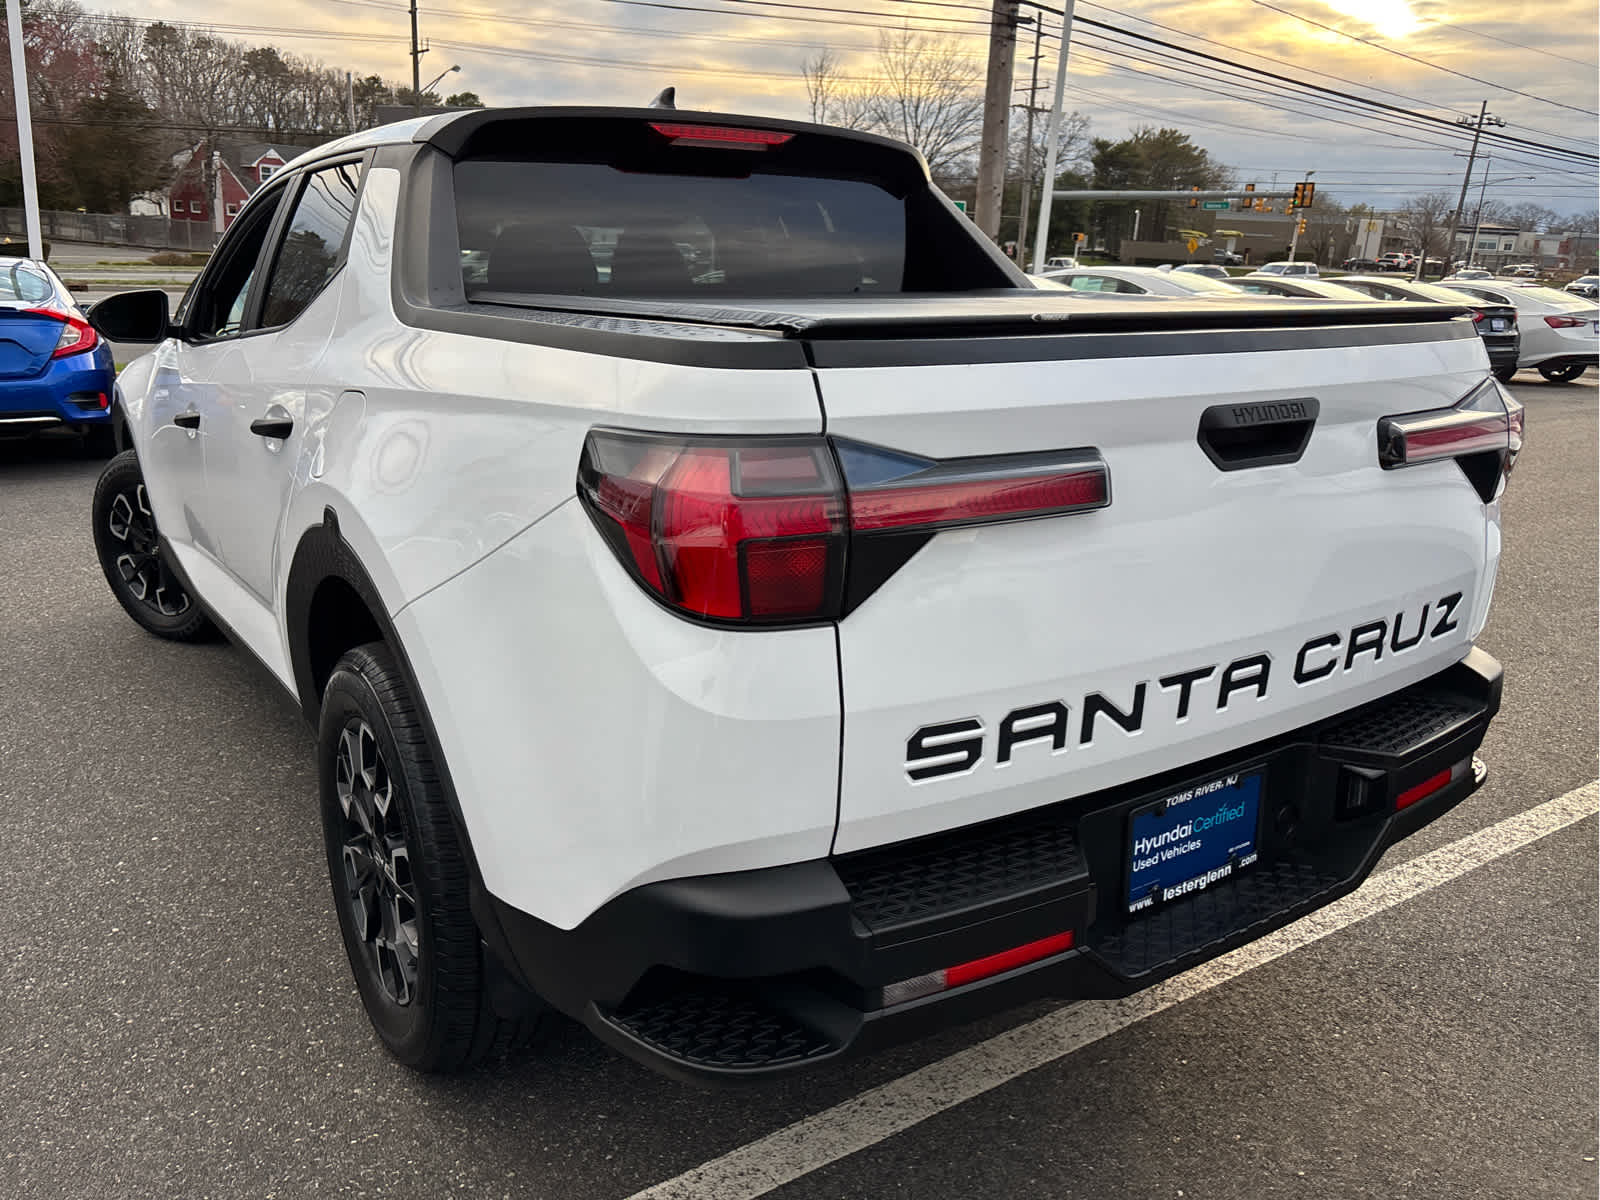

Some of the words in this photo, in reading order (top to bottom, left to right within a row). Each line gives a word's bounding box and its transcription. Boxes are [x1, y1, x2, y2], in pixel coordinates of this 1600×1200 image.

[1231, 403, 1307, 424] HYUNDAI
[905, 652, 1273, 781] SANTA
[1294, 592, 1463, 686] CRUZ
[1165, 790, 1193, 808] TOMS
[1226, 775, 1239, 787] NJ
[1133, 820, 1193, 856] Hyundai
[1193, 802, 1245, 833] Certified
[1132, 853, 1159, 872] Used
[1160, 839, 1202, 862] Vehicles
[1162, 865, 1232, 901] lesterglenn
